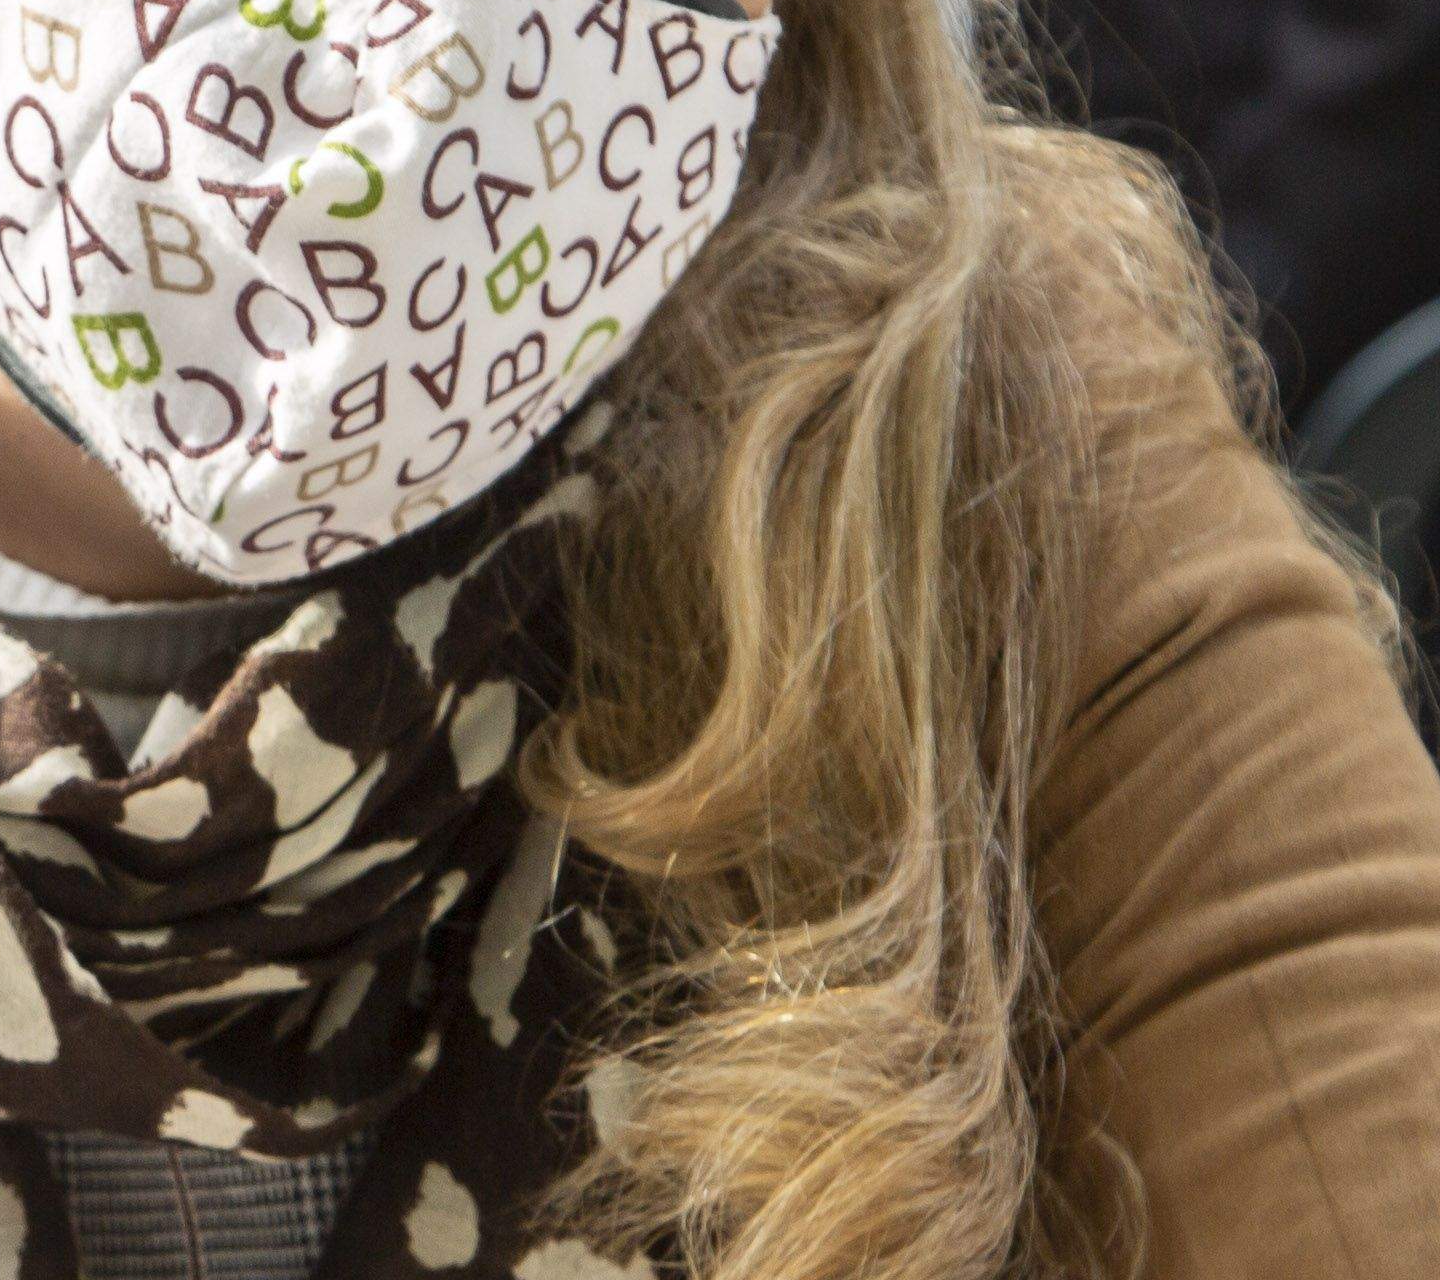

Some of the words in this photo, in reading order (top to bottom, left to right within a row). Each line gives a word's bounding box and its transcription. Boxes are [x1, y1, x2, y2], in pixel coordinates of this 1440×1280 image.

[21, 4, 82, 92] B
[388, 32, 487, 125] B
[506, 9, 552, 101] C
[648, 13, 705, 100] B
[3, 93, 64, 189] C
[107, 91, 172, 183] C
[185, 62, 275, 162] B
[535, 100, 586, 192] B
[599, 103, 657, 193] C
[422, 127, 480, 220] C
[474, 172, 536, 254] A
[56, 179, 133, 297] A
[136, 200, 216, 296] B
[485, 223, 551, 315] B
[540, 235, 600, 319] C
[234, 277, 318, 361] C
[299, 239, 388, 329] B
[408, 255, 468, 332] C
[71, 312, 162, 391] B
[409, 320, 467, 411] A
[153, 365, 245, 460] C
[331, 361, 388, 441] B
